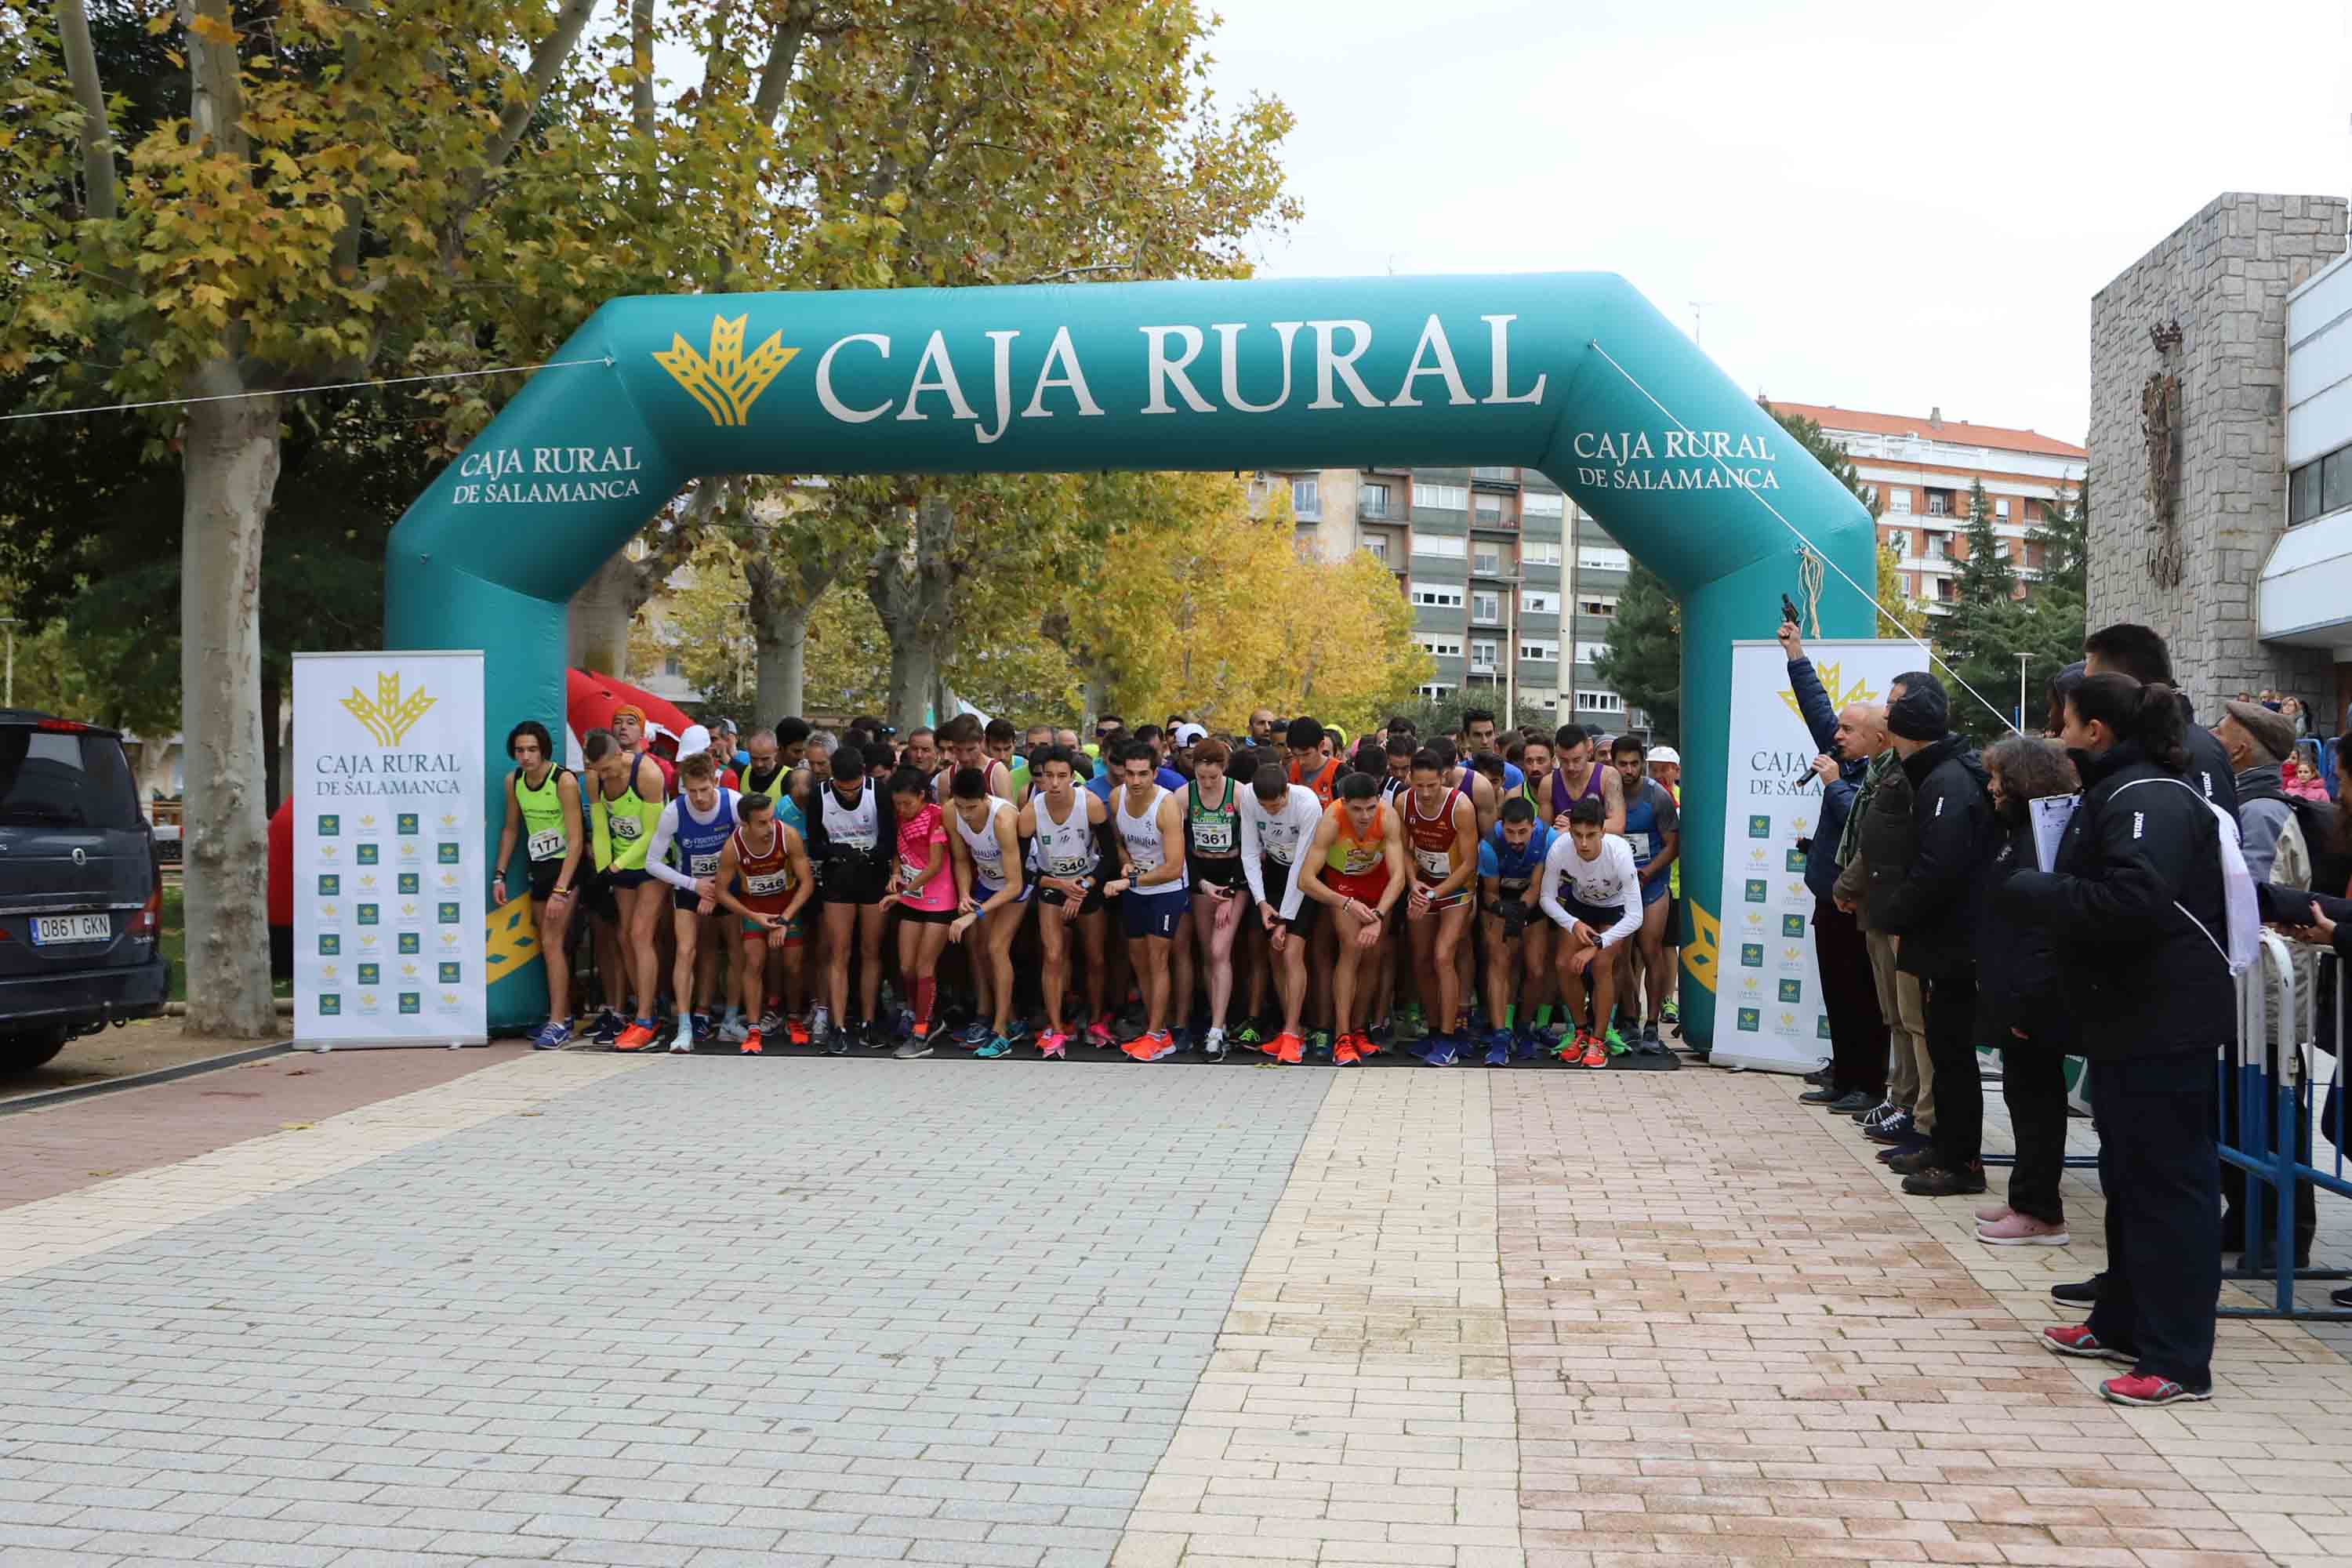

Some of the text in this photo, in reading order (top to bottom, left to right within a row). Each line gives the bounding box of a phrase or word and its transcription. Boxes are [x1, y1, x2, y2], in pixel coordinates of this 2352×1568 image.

[815, 314, 1547, 444] CAJA RURAL
[1573, 430, 1776, 466] CAJA RURAL
[460, 446, 641, 481] CAJA RURAL
[1578, 467, 1780, 489] DE SALAMANCA
[452, 478, 641, 504] DE SALAMANCA
[316, 753, 462, 779] CAJA RURAL
[1751, 750, 1808, 778] CAJA
[317, 779, 461, 796] DE SALAMANCA
[1750, 779, 1823, 797] DE SALA
[537, 837, 559, 854] 177
[1201, 833, 1227, 844] 361
[700, 862, 717, 872] 36
[1059, 858, 1085, 873] 340
[1428, 861, 1437, 871] 7
[757, 878, 784, 891] 346
[41, 915, 109, 937] 0861 GKN
